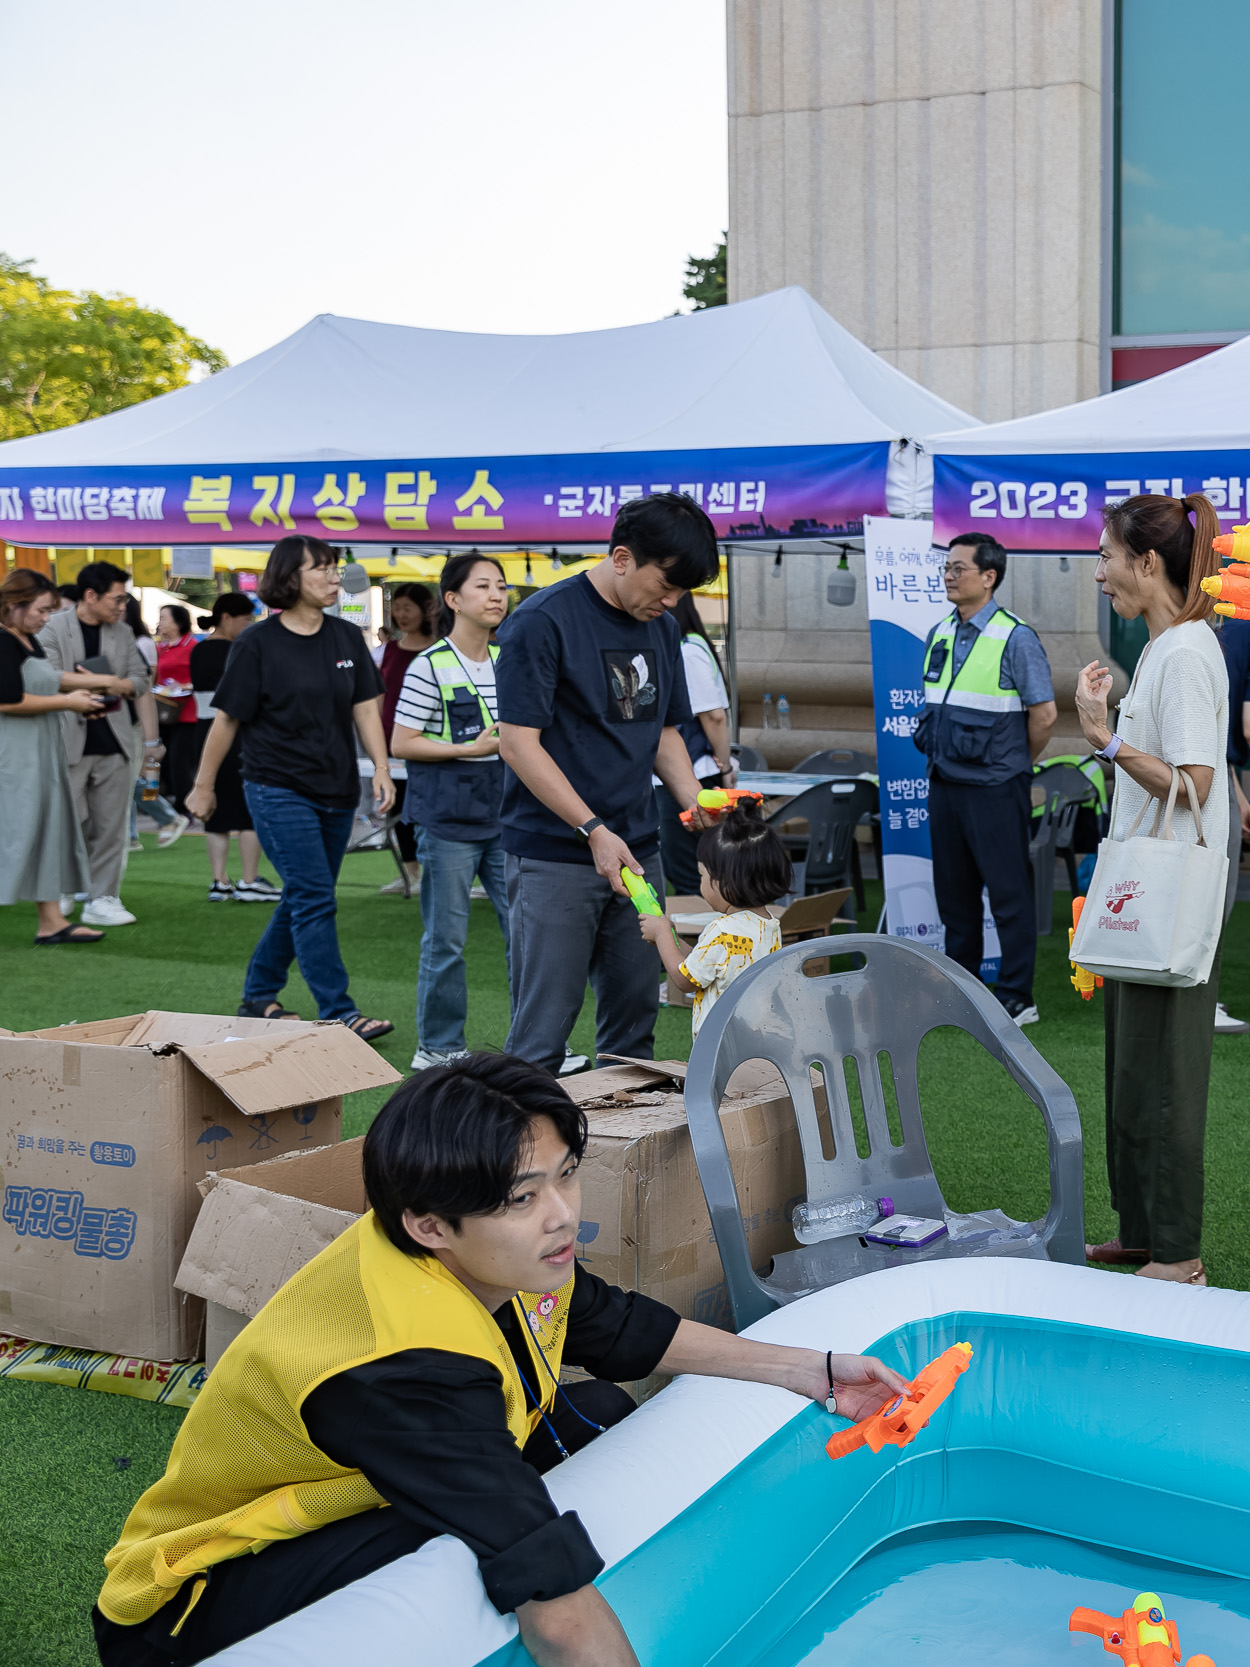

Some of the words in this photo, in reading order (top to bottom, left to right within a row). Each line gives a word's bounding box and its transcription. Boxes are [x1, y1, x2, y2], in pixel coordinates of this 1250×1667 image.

[29, 486, 167, 521] 한마당축제
[183, 469, 505, 532] 복지상담소
[968, 480, 1088, 520] 2023
[887, 808, 904, 830] 늘
[1114, 880, 1141, 894] WHY
[1098, 915, 1140, 932] Pilates?
[17, 1134, 35, 1150] 꿈과
[38, 1136, 65, 1155] 희망을
[67, 1140, 87, 1157] 주는
[3, 1185, 85, 1240] 파워킹
[74, 1206, 137, 1261] 물총
